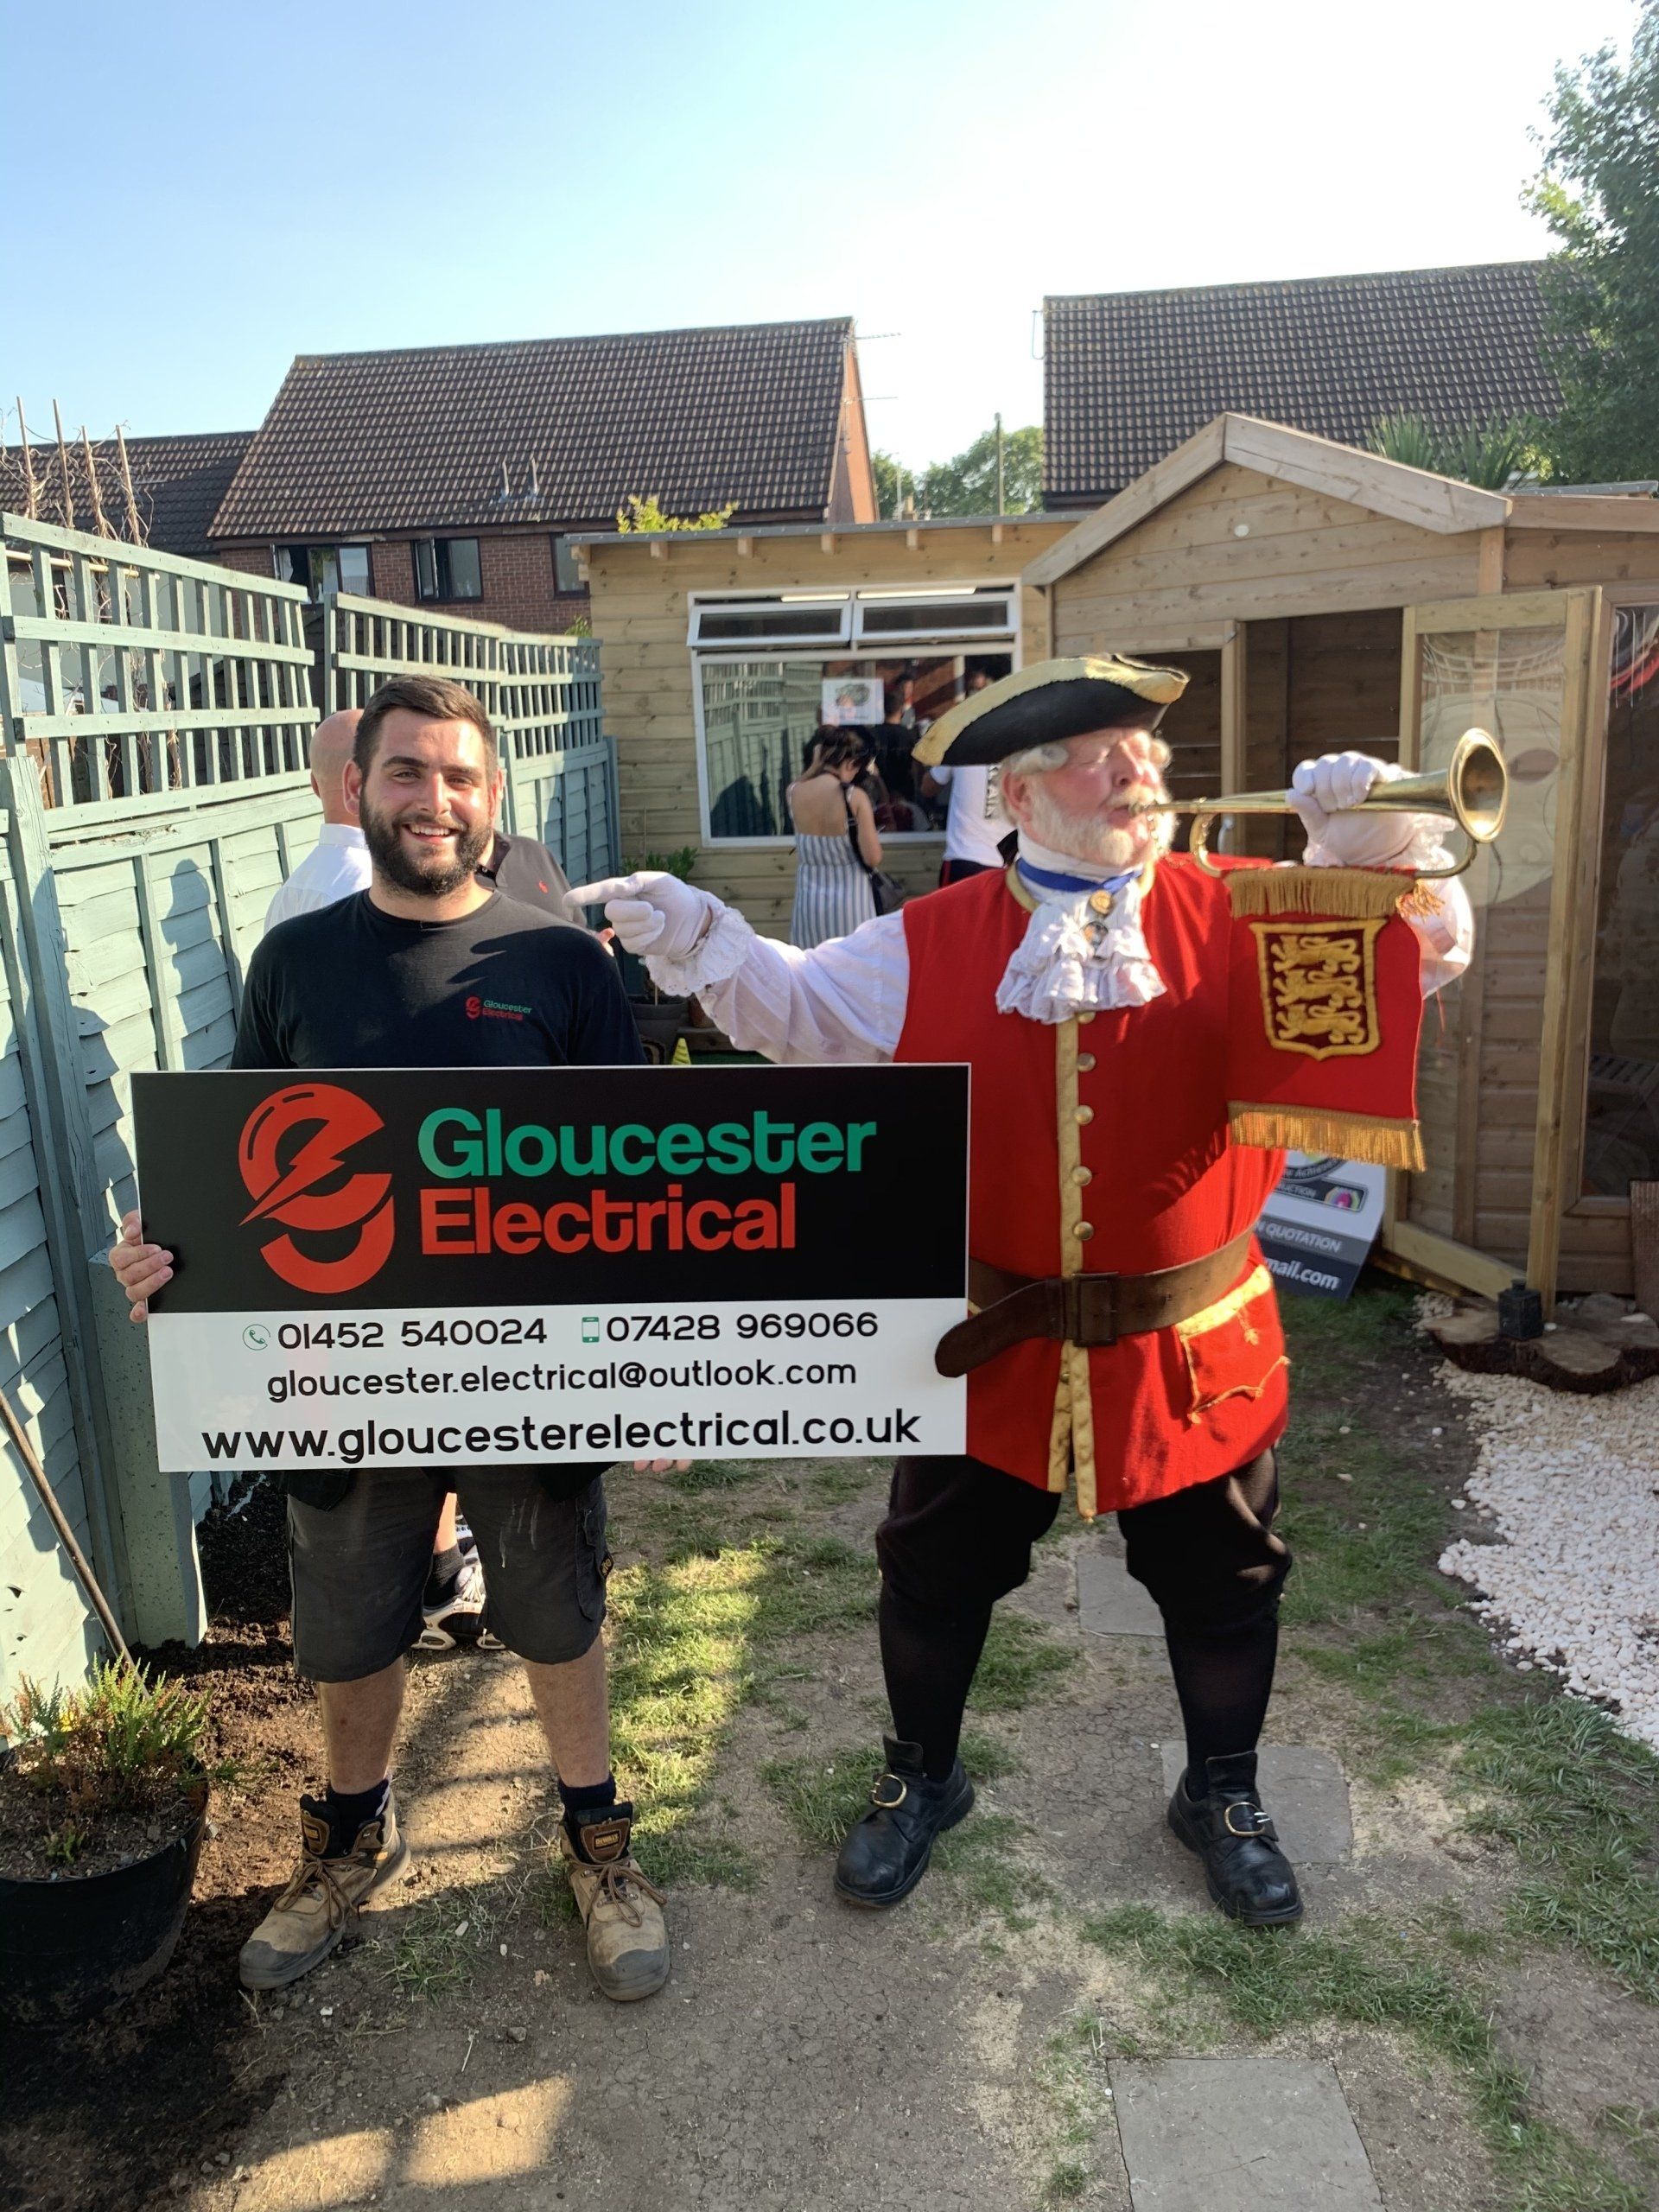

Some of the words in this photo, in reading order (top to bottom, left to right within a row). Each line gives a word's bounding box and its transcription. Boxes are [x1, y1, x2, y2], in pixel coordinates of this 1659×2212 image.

[483, 1000, 533, 1014] Gloucester
[417, 1107, 877, 1179] Gloucester
[421, 1183, 796, 1255] Electrical
[1266, 1223, 1343, 1253] QUOTATION
[276, 1321, 385, 1351] 01452
[401, 1318, 548, 1348] 540024
[606, 1314, 721, 1343] 07428
[736, 1311, 879, 1340] 969066
[266, 1358, 857, 1403] gloucester.electrical@outlook.com
[201, 1408, 922, 1463] www.gloucesterelectrical.co.uk
